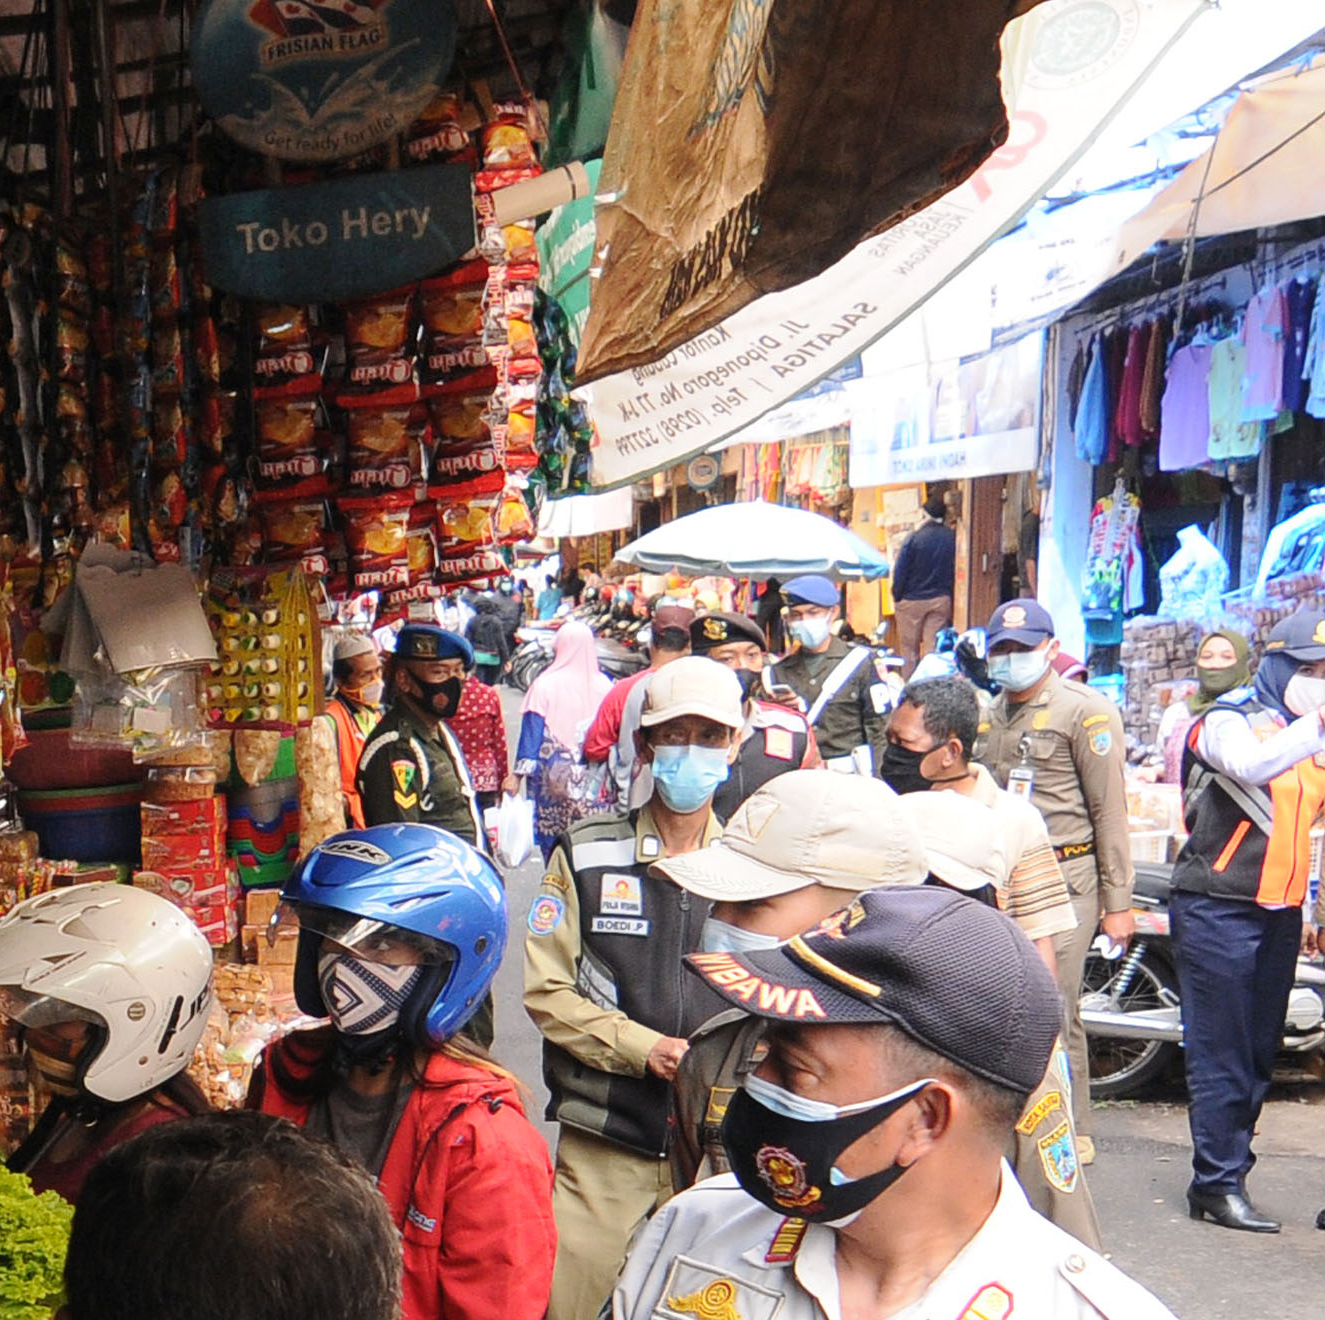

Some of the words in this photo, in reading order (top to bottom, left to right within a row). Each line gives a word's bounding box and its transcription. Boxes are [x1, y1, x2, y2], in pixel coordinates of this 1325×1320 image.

[267, 37, 333, 61] FRISIAN
[339, 29, 381, 50] FLAG
[264, 131, 292, 148] Get
[298, 134, 340, 151] ready
[342, 130, 365, 146] for
[236, 217, 329, 254] Toko
[340, 204, 431, 241] Hery
[596, 919, 631, 931] BOEDI
[689, 952, 827, 1018] WIBAWA
